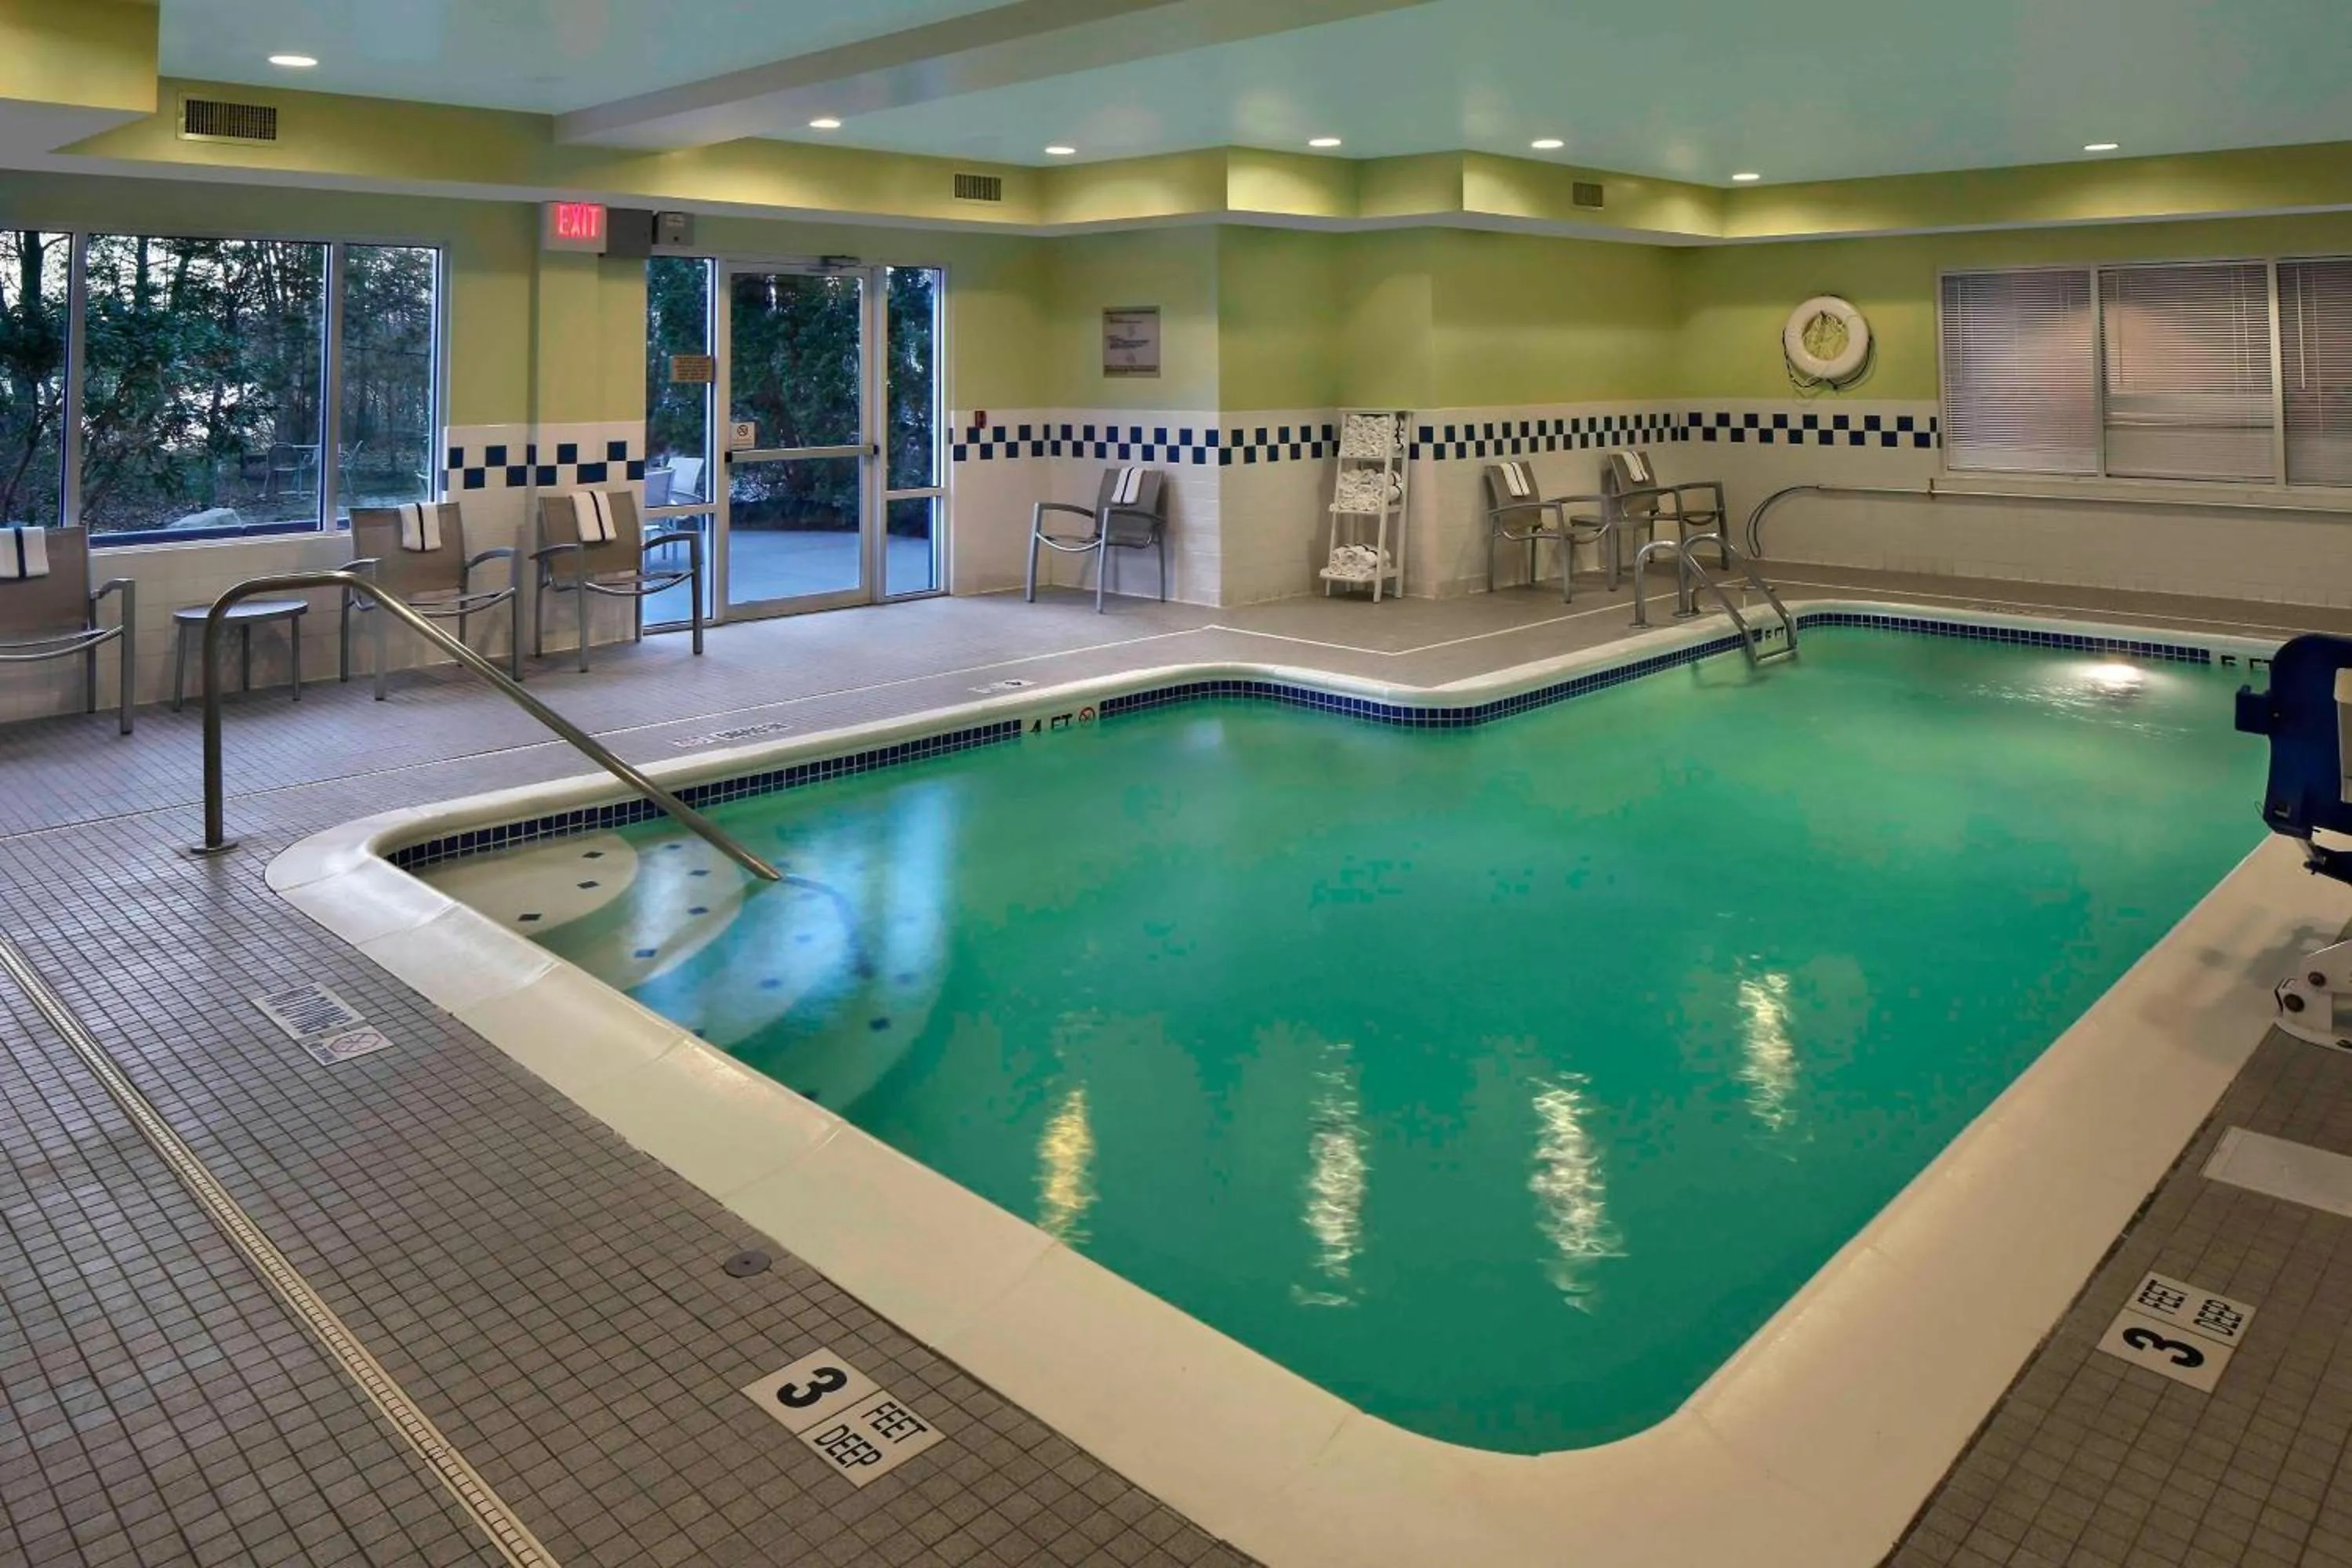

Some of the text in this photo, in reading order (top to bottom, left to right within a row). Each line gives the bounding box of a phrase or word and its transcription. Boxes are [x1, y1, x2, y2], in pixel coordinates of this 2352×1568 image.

[559, 205, 601, 236] EXIT
[2138, 1279, 2188, 1315] FEET
[2194, 1299, 2244, 1336] DEEP
[2122, 1327, 2204, 1367] 3
[776, 1367, 848, 1408] 3
[861, 1401, 927, 1443] FEET
[813, 1424, 882, 1468] DEEP
